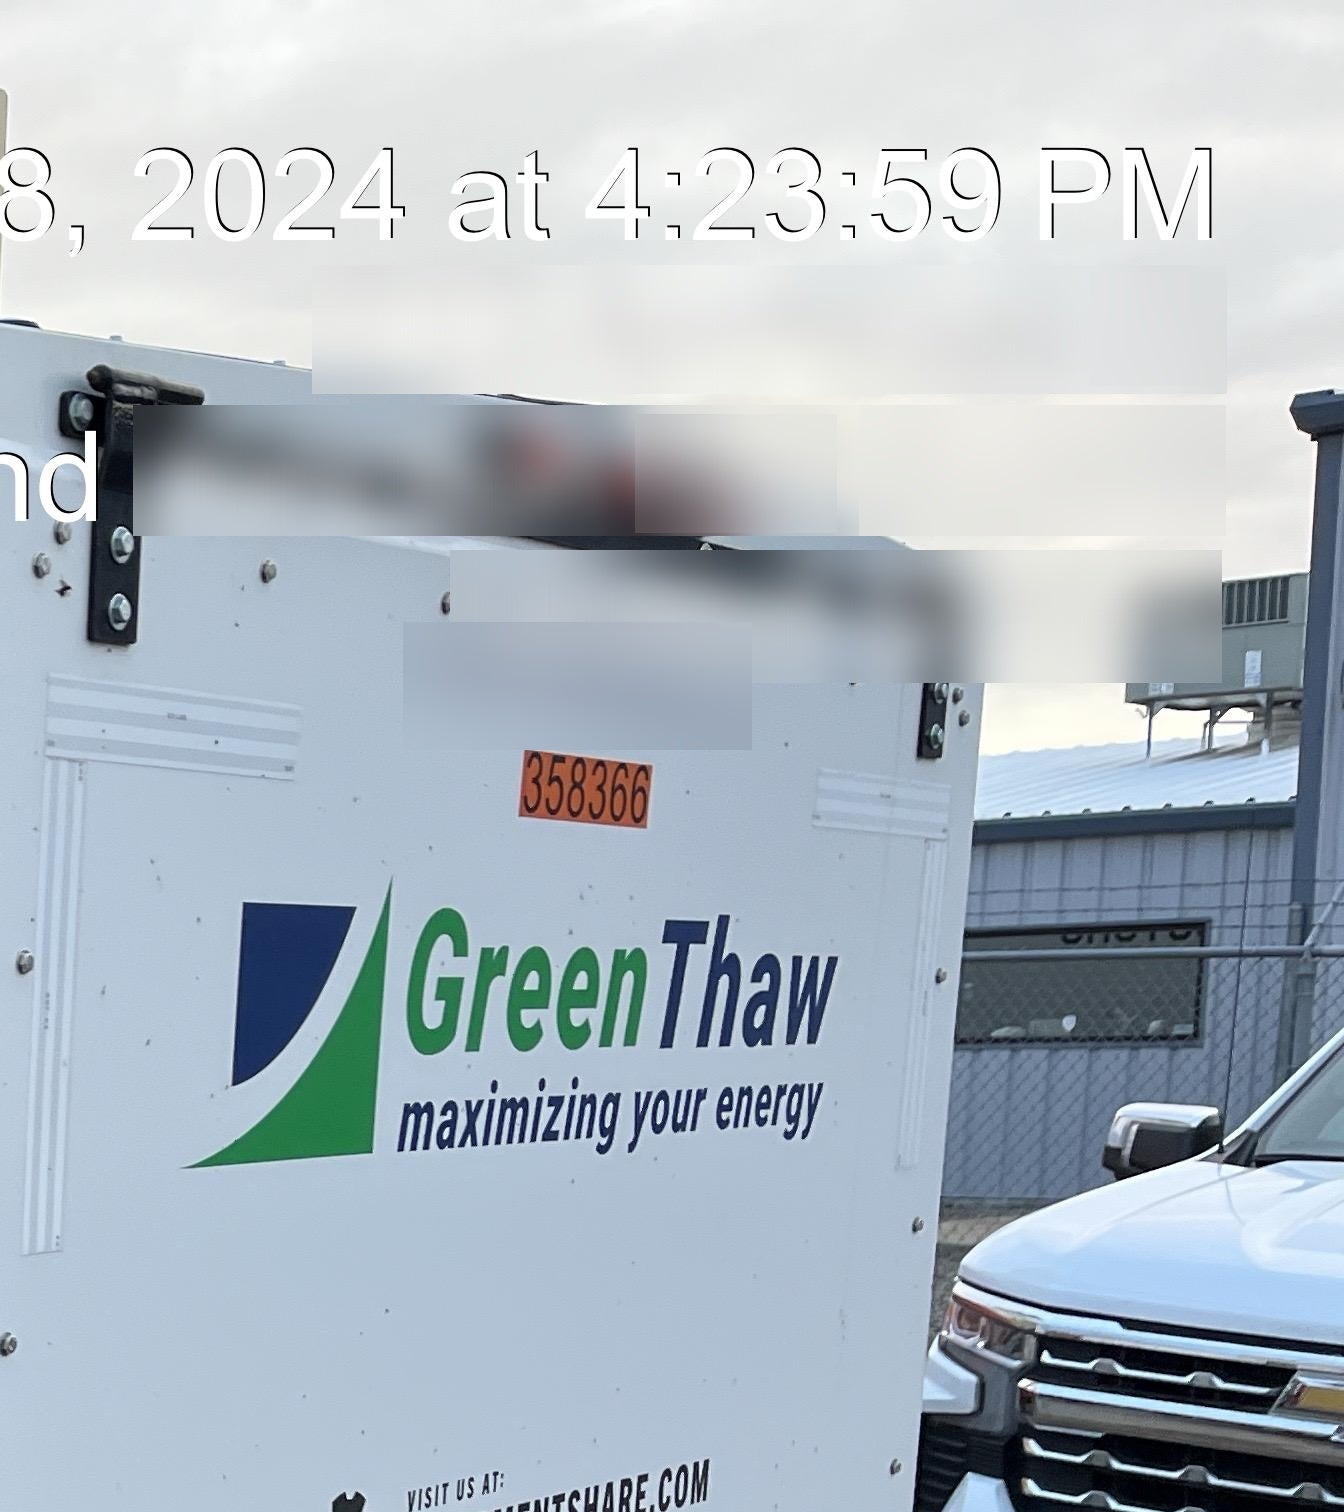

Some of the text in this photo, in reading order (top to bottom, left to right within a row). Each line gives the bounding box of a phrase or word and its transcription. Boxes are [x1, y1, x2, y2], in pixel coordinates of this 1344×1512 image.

[523, 751, 648, 824] 358366
[396, 1076, 824, 1155] maximizing your energy
[407, 1470, 505, 1512] VISIT US AT:
